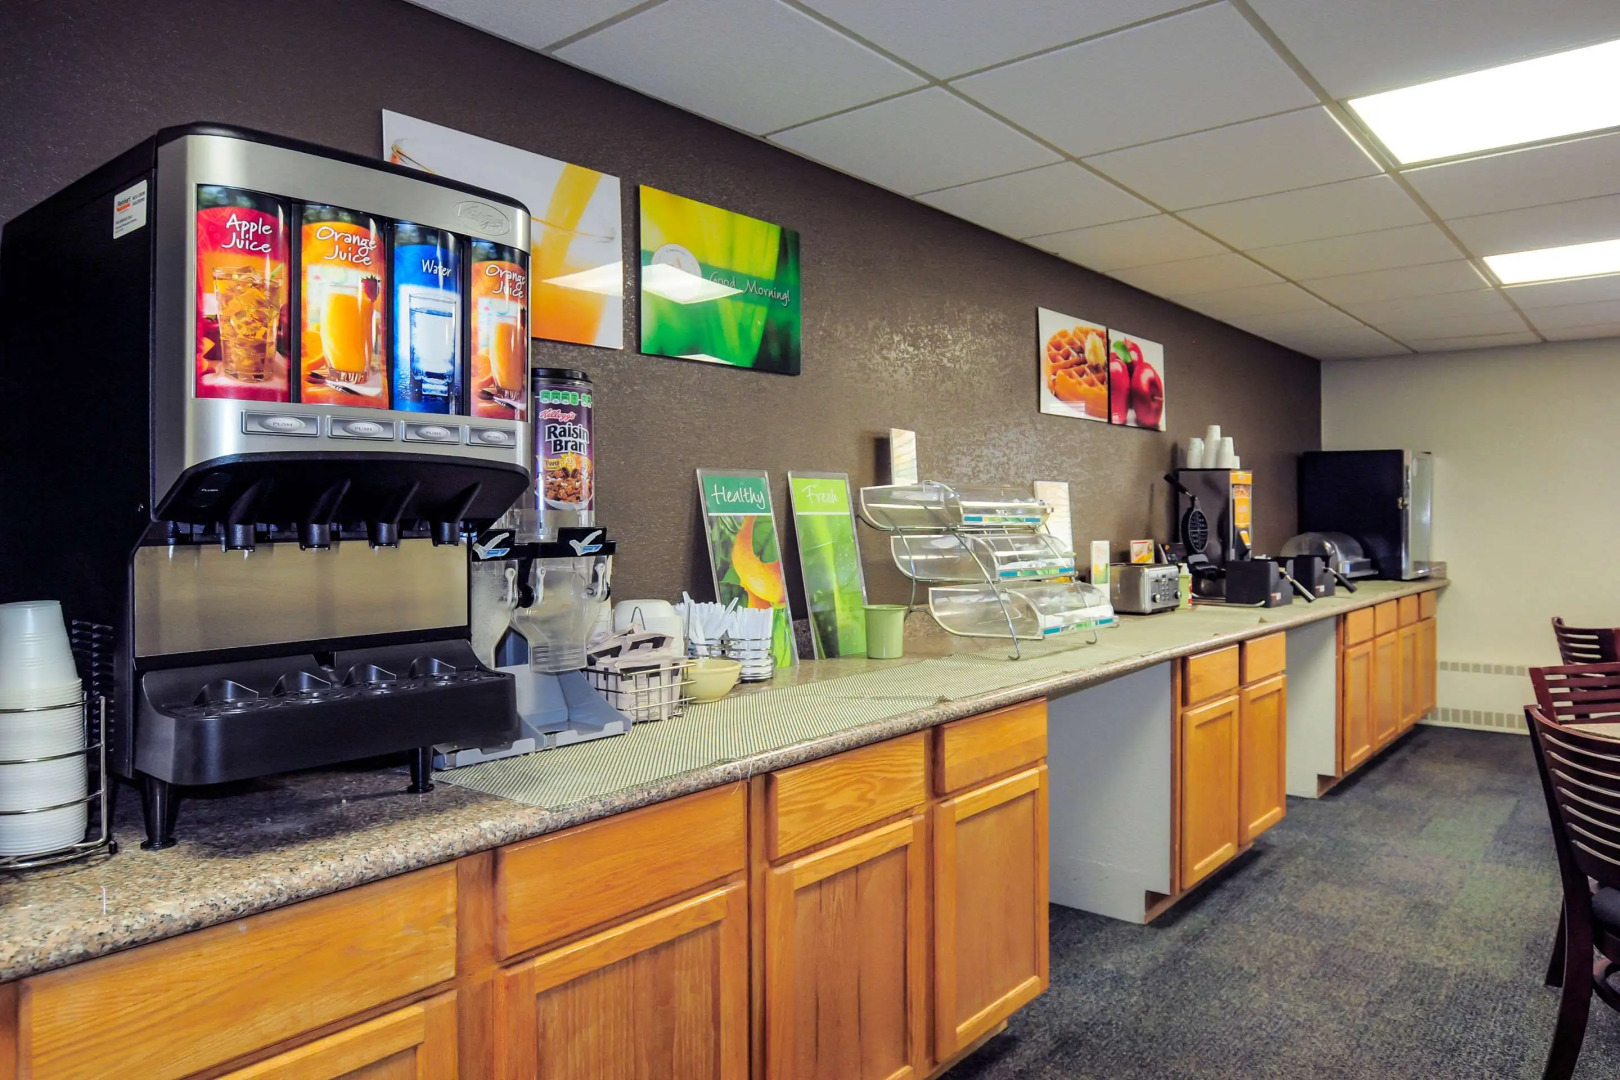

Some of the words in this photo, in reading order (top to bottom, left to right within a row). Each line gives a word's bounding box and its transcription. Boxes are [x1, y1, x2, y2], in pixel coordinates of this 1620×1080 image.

[226, 213, 272, 240] Apple
[222, 232, 271, 253] Juice
[316, 225, 377, 257] Orange
[324, 245, 373, 266] Juice
[421, 259, 452, 277] Water
[485, 264, 526, 291] Orange
[491, 280, 524, 298] Juice
[742, 279, 790, 306] Morning!
[539, 408, 578, 423] Kellogg's
[546, 423, 589, 442] Raisin
[552, 439, 587, 455] Bran
[711, 484, 766, 510] Healthy
[802, 484, 838, 504] Fresh
